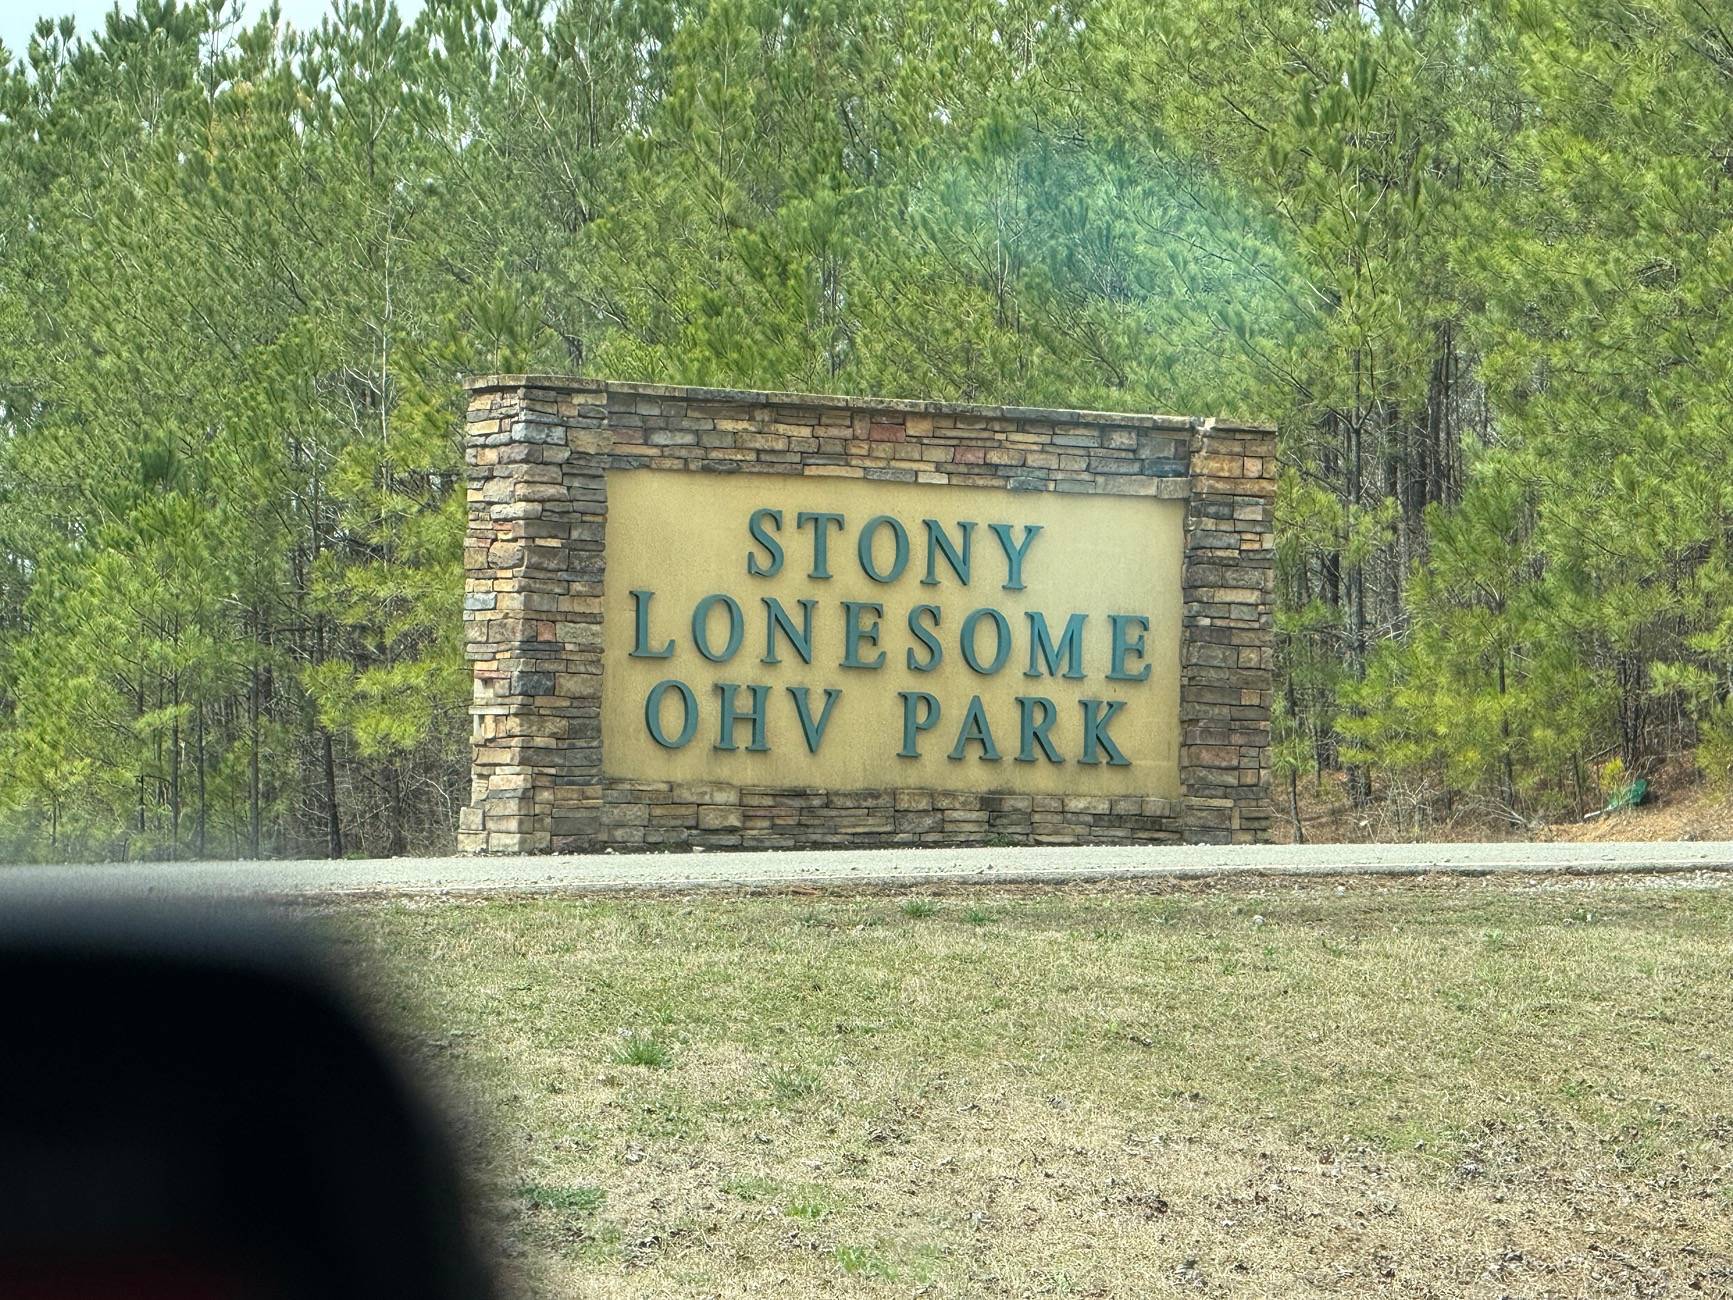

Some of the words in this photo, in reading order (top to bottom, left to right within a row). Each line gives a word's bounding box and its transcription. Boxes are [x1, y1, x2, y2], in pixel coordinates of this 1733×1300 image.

[746, 507, 1046, 592] STONY
[629, 588, 1153, 683] LONESOME
[644, 678, 842, 754] OHV
[896, 690, 1132, 767] PARK
